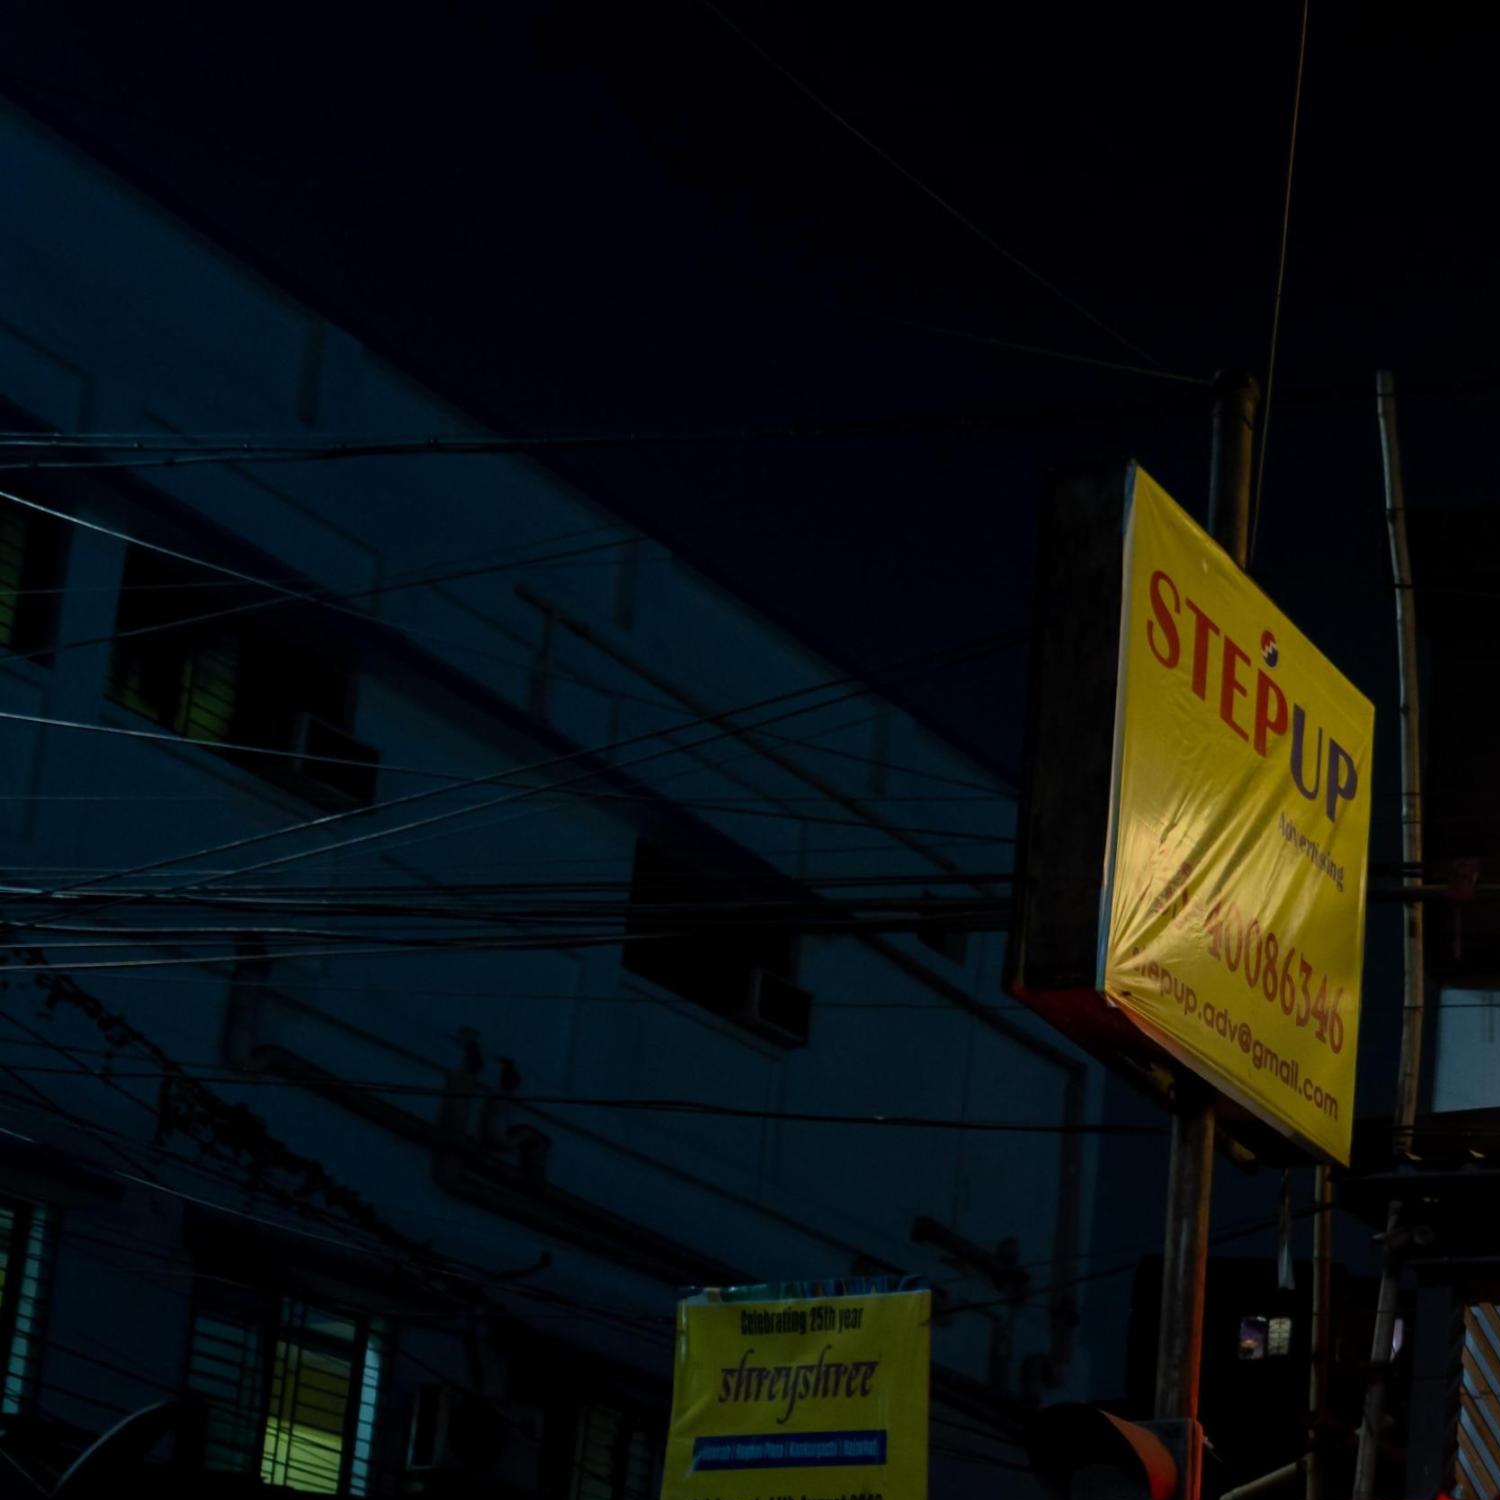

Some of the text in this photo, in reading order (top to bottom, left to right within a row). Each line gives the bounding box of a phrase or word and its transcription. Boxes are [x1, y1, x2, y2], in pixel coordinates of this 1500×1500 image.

[741, 1306, 864, 1335] Celebrating 25th year
[718, 1344, 880, 1424] shreyshree
